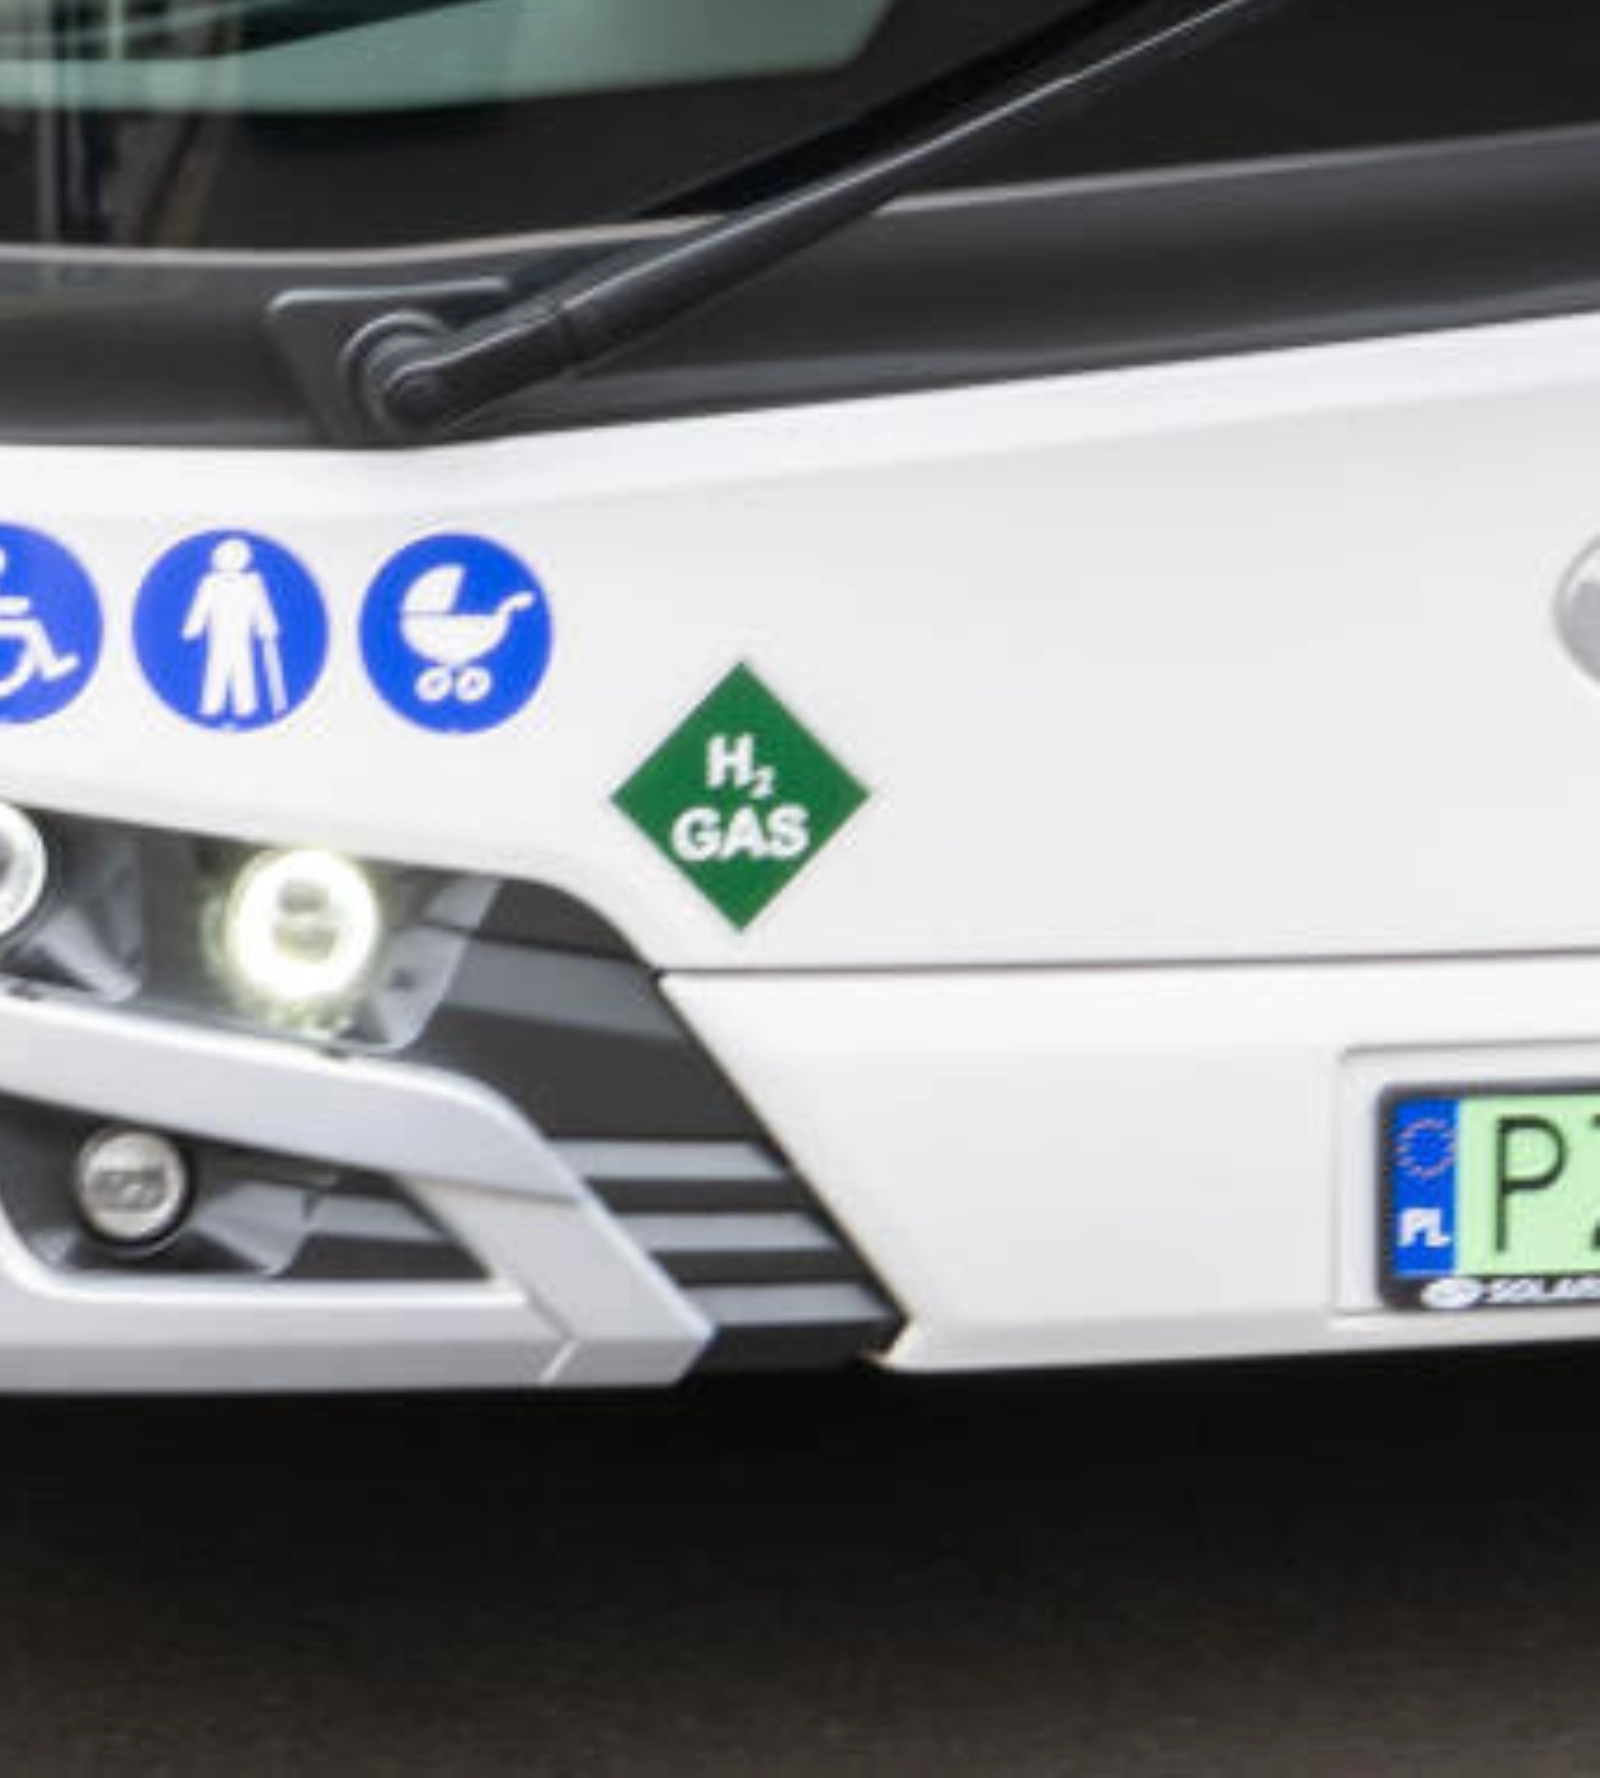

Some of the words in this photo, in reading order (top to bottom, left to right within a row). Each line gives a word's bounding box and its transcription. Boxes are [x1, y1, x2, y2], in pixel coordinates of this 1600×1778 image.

[671, 804, 812, 862] GAS
[1496, 1113, 1600, 1256] P
[1400, 1207, 1450, 1246] PL
